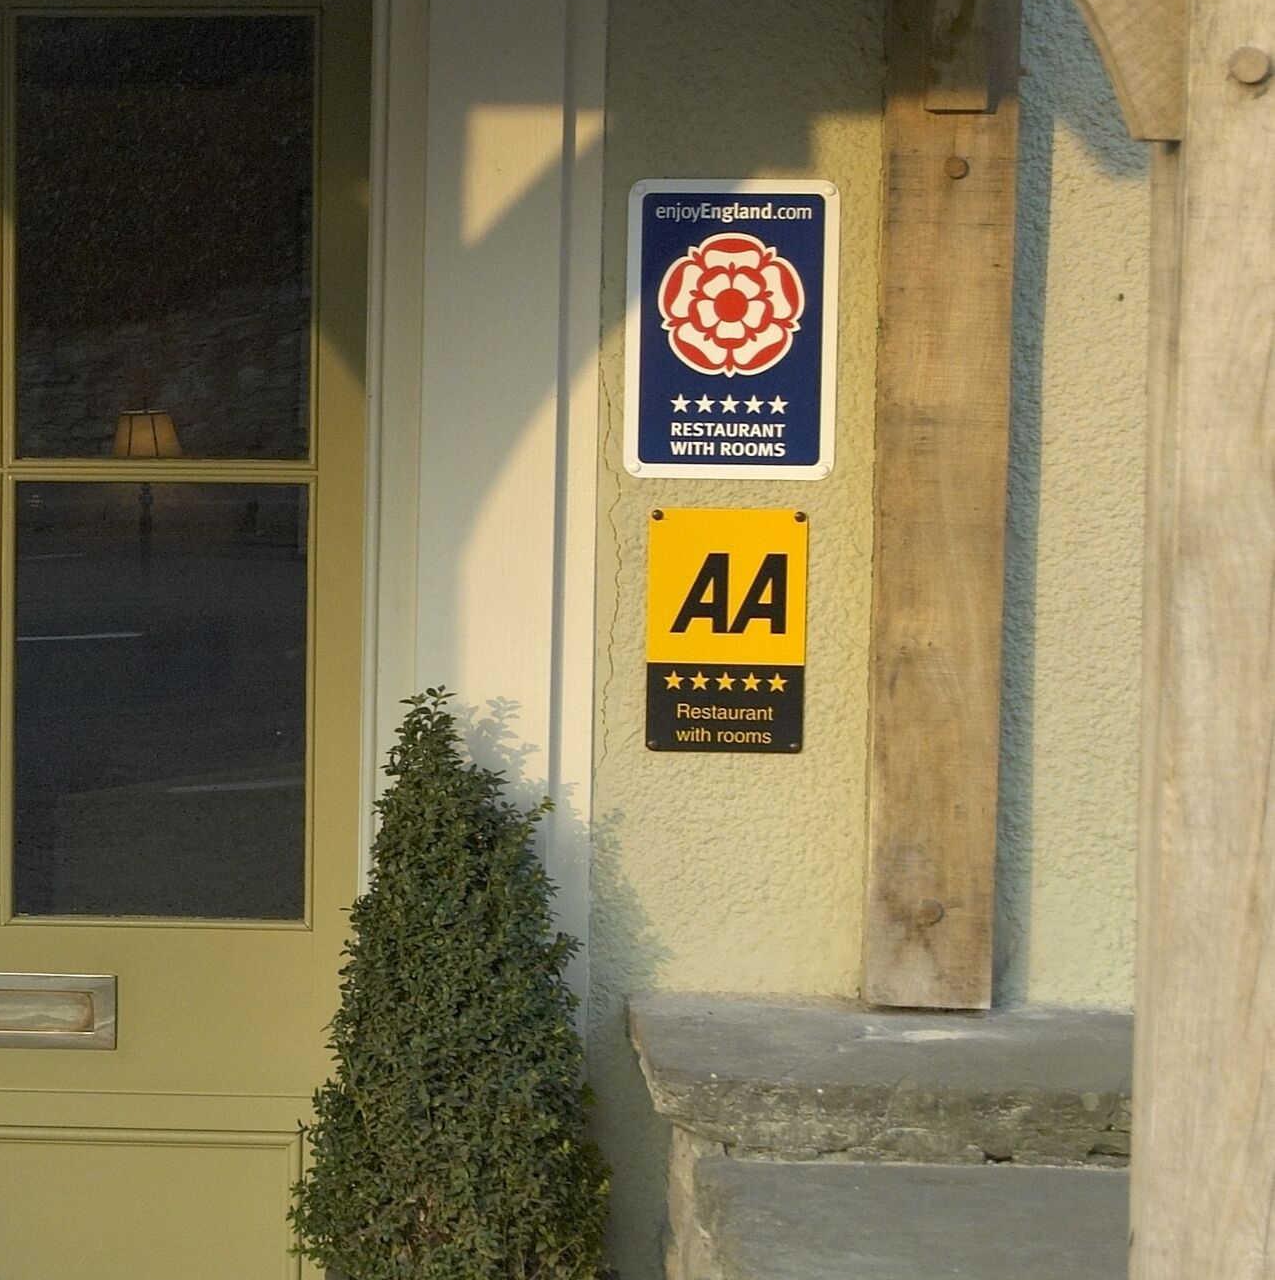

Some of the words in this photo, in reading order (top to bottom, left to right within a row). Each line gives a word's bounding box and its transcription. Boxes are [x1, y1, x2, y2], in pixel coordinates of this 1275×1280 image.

[656, 202, 812, 223] enjoyEngland.com
[671, 422, 785, 438] RESTAURANT
[671, 440, 714, 456] WITH
[720, 441, 786, 458] ROOMS
[669, 552, 788, 634] AA
[676, 703, 774, 721] Restaurant
[676, 727, 711, 742] with
[717, 730, 772, 744] rooms
